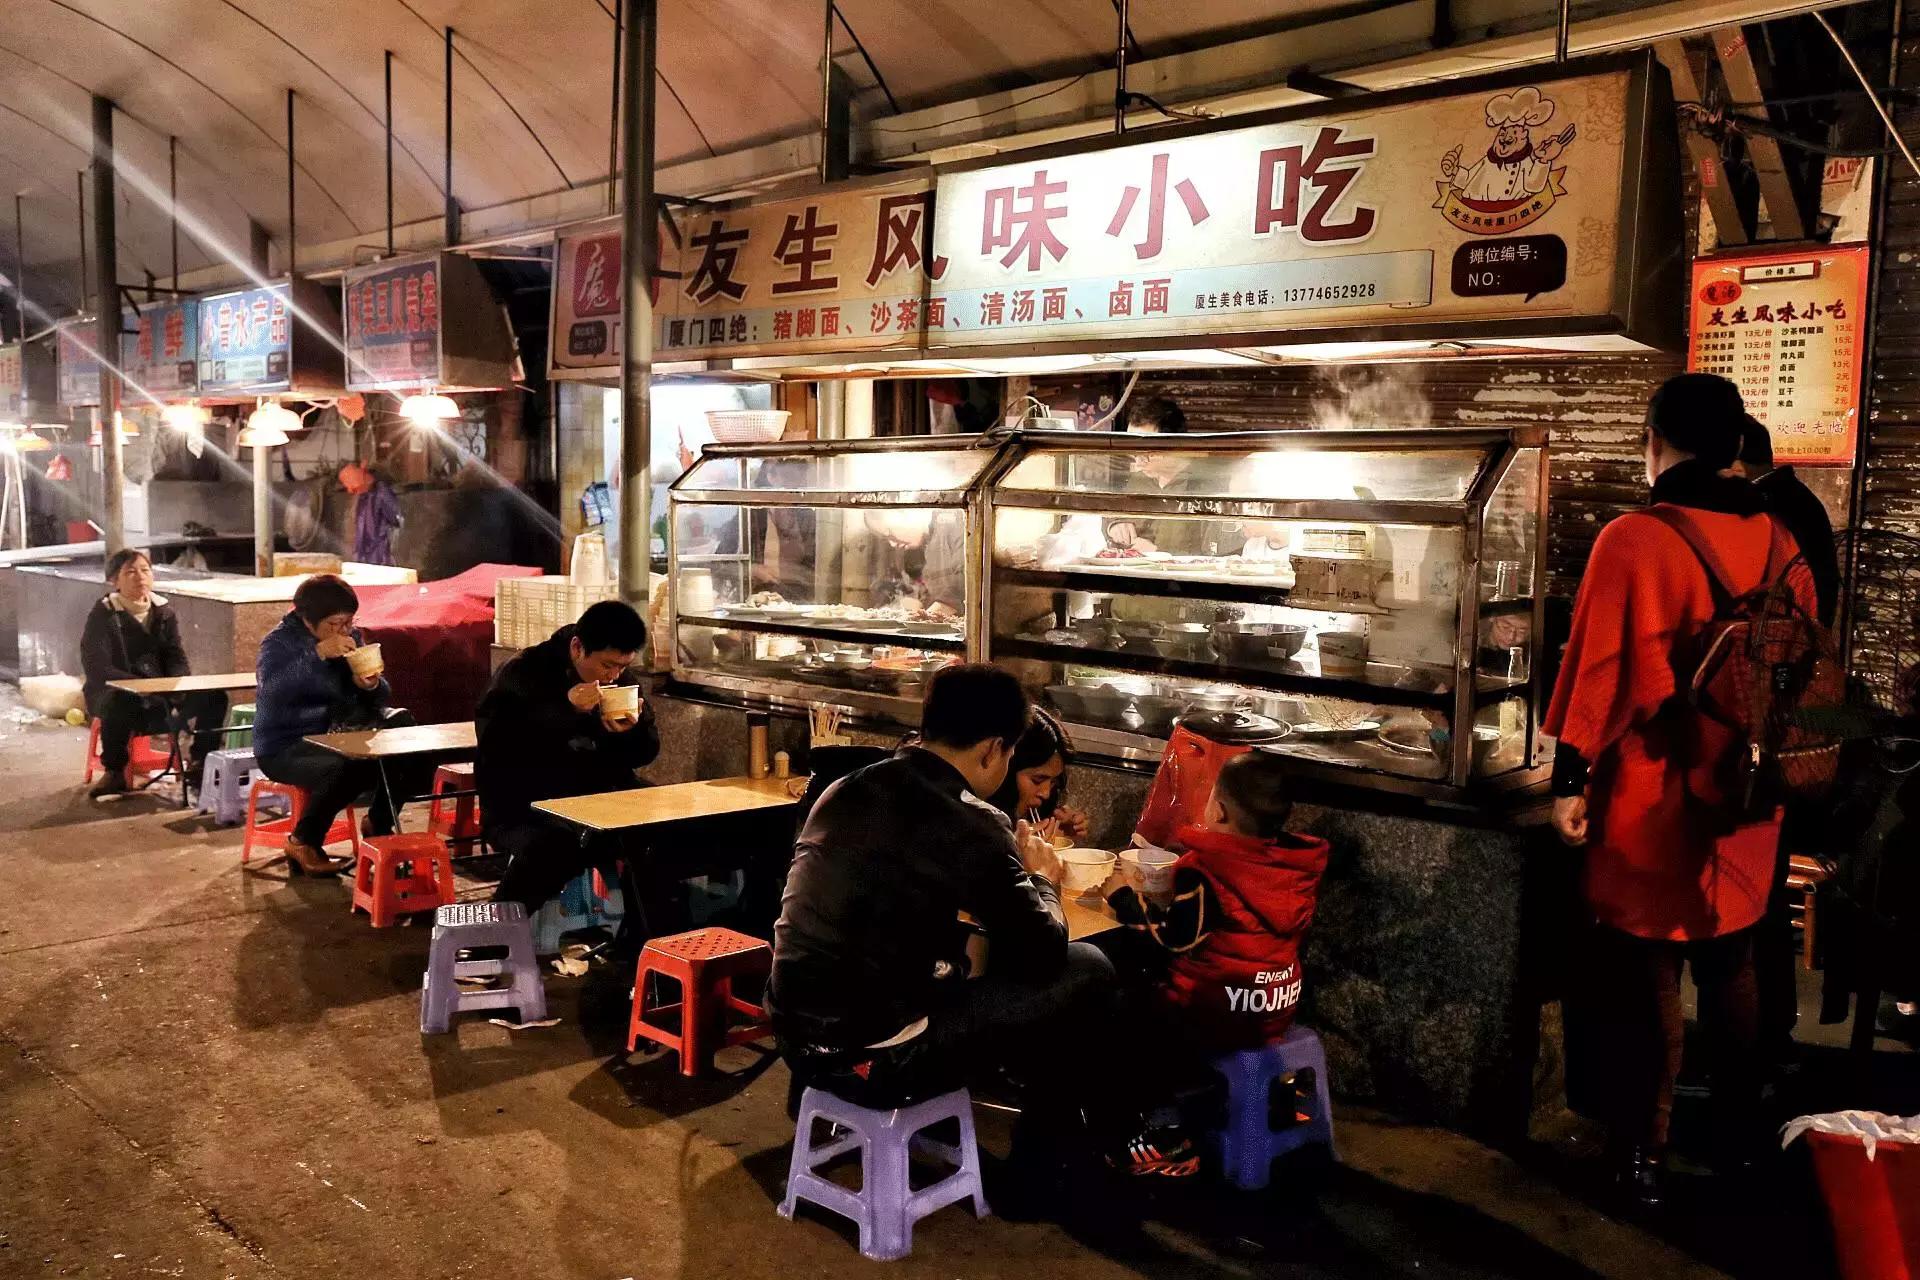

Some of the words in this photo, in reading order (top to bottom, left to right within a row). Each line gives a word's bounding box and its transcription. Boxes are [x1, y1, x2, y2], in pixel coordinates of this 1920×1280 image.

[687, 126, 1376, 303] 友生风味小吃
[1469, 245, 1538, 265] 摊位编号：
[1468, 272, 1501, 288] NO:
[1765, 267, 1796, 276] 价格表
[1283, 283, 1376, 303] 13774652928
[1706, 299, 1847, 327] 友生风味小吃
[668, 314, 758, 347] 厦门四绝：
[1744, 399, 1768, 409] 3元/份
